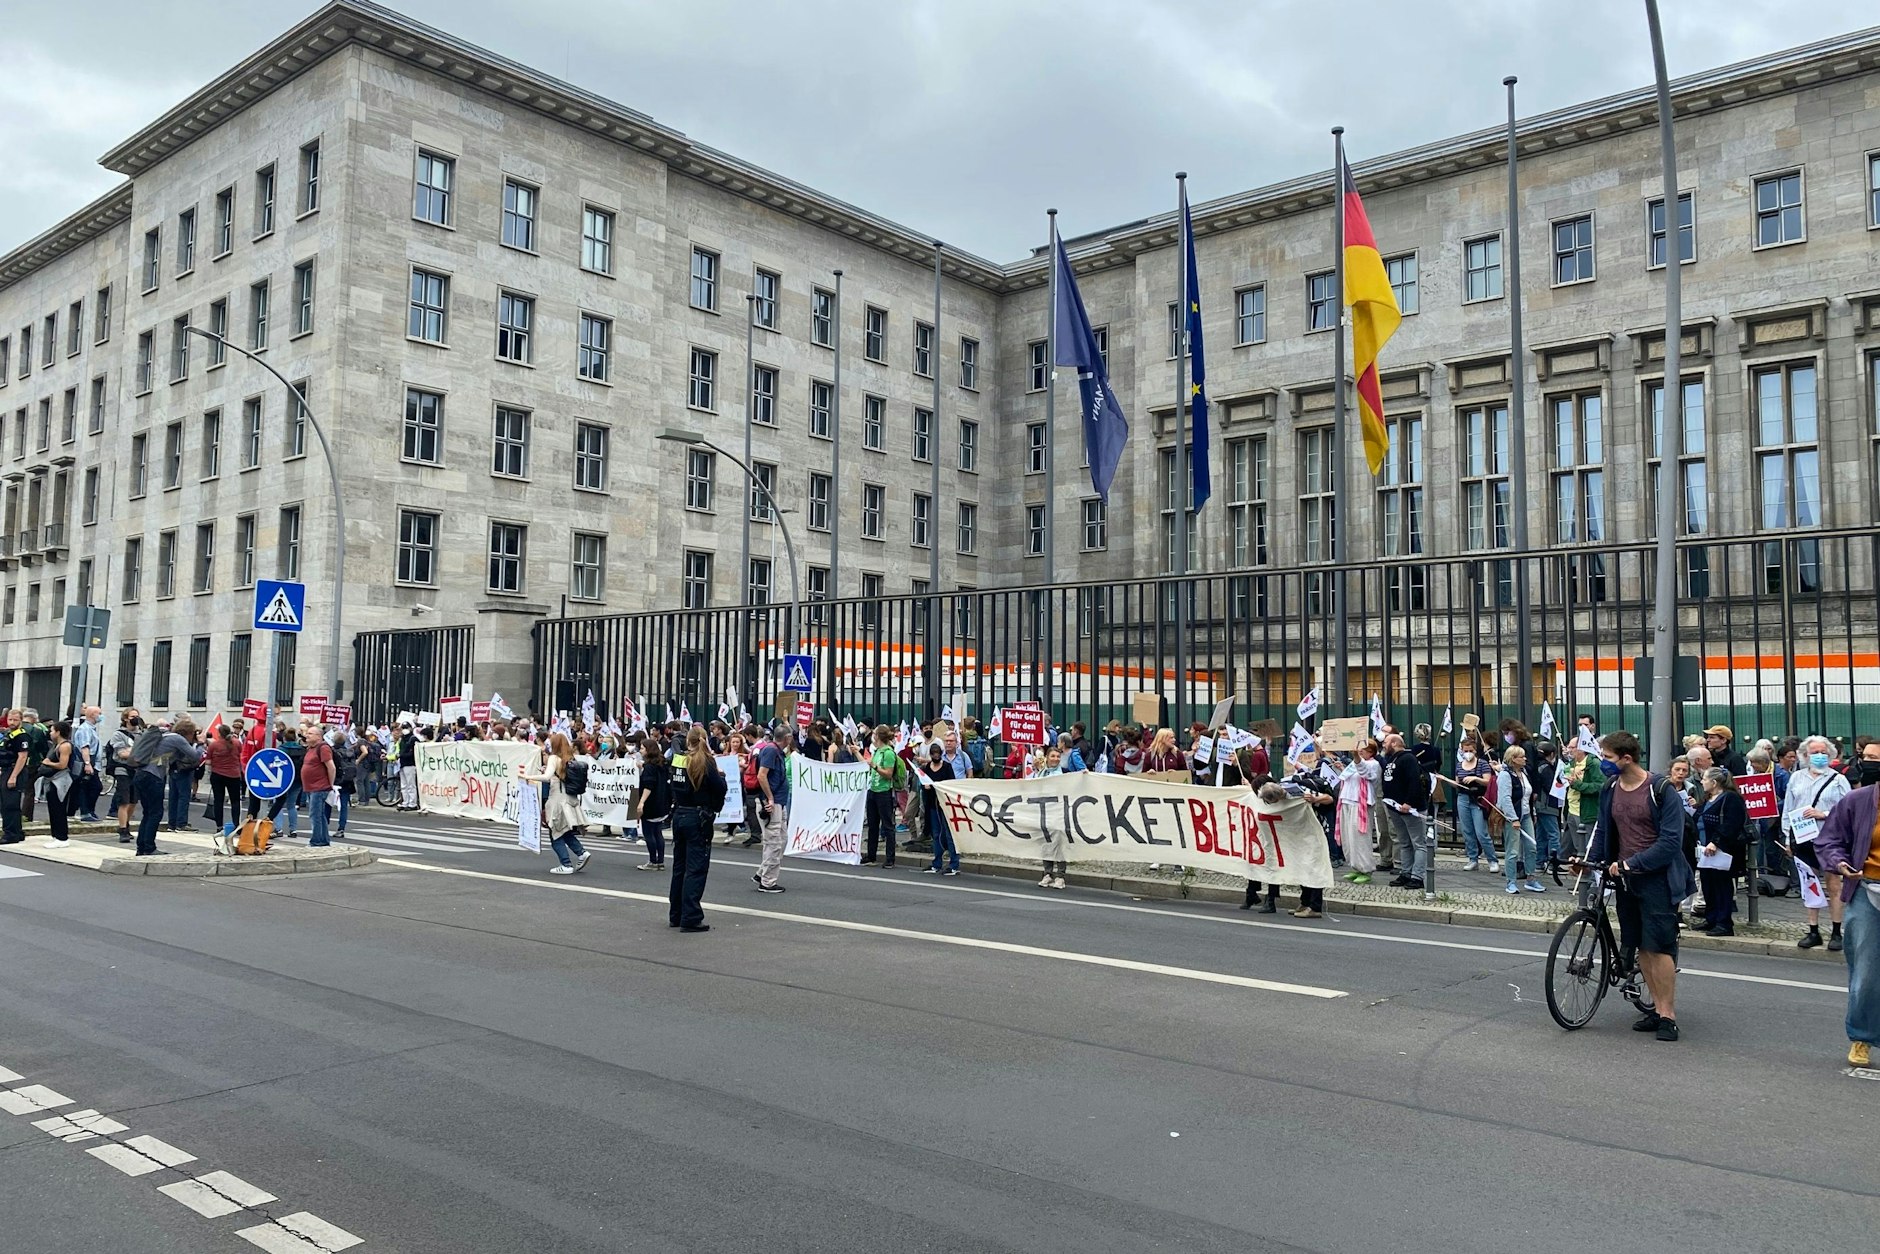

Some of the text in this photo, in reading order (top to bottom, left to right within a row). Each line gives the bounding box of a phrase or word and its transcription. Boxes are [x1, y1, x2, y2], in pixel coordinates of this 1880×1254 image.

[1005, 711, 1040, 721] Mehr Geld
[1010, 720, 1036, 730] für den
[1011, 729, 1034, 741] ÖPNV!
[419, 745, 508, 778] Verkehrswende
[461, 772, 499, 810] ÖPNV
[1739, 782, 1771, 794] Ticket
[1794, 819, 1815, 830] Ticket
